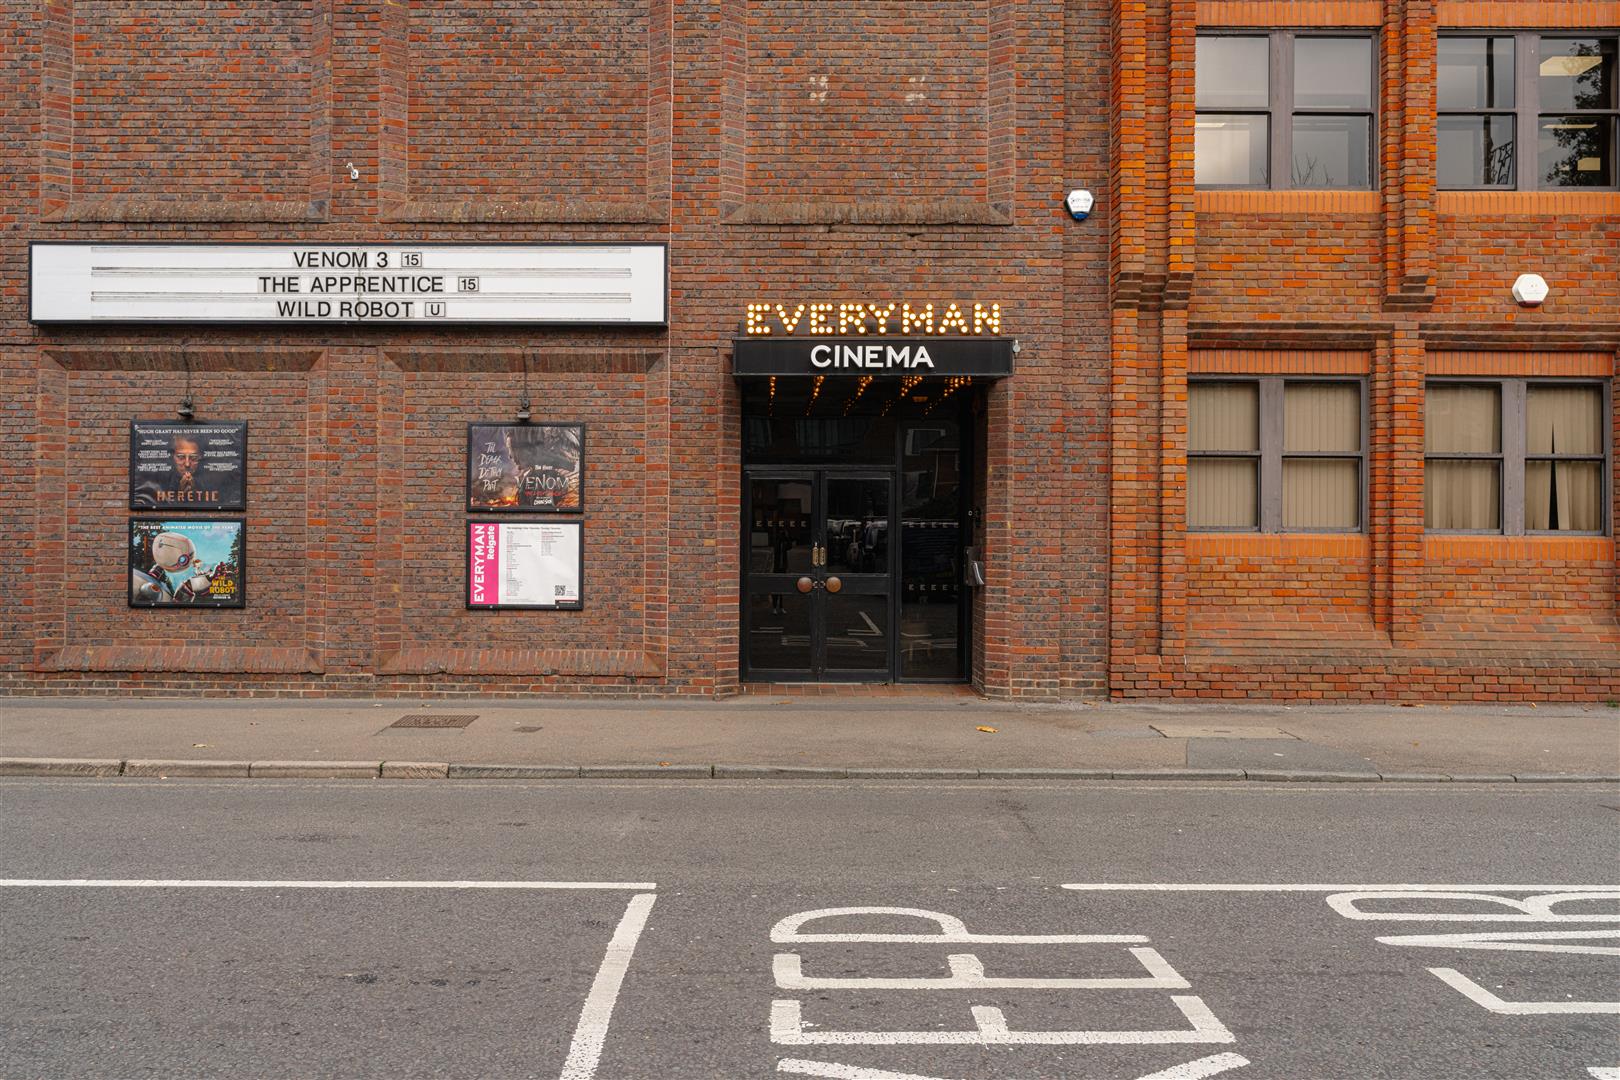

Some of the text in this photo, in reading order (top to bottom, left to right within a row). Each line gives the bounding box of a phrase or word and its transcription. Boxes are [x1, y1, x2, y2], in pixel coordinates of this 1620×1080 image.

[293, 252, 420, 268] VENOM 3 15
[258, 276, 476, 292] THE APPRENTICE 15
[278, 301, 440, 317] WILD ROBOT U
[746, 302, 1001, 336] EVERYMAN
[810, 344, 934, 369] CINEMA
[514, 474, 569, 490] VENOM
[156, 490, 219, 502] HERETIC
[487, 526, 496, 560] Reigate
[474, 526, 485, 602] EVERYMAN
[770, 906, 1250, 1080] EEP
